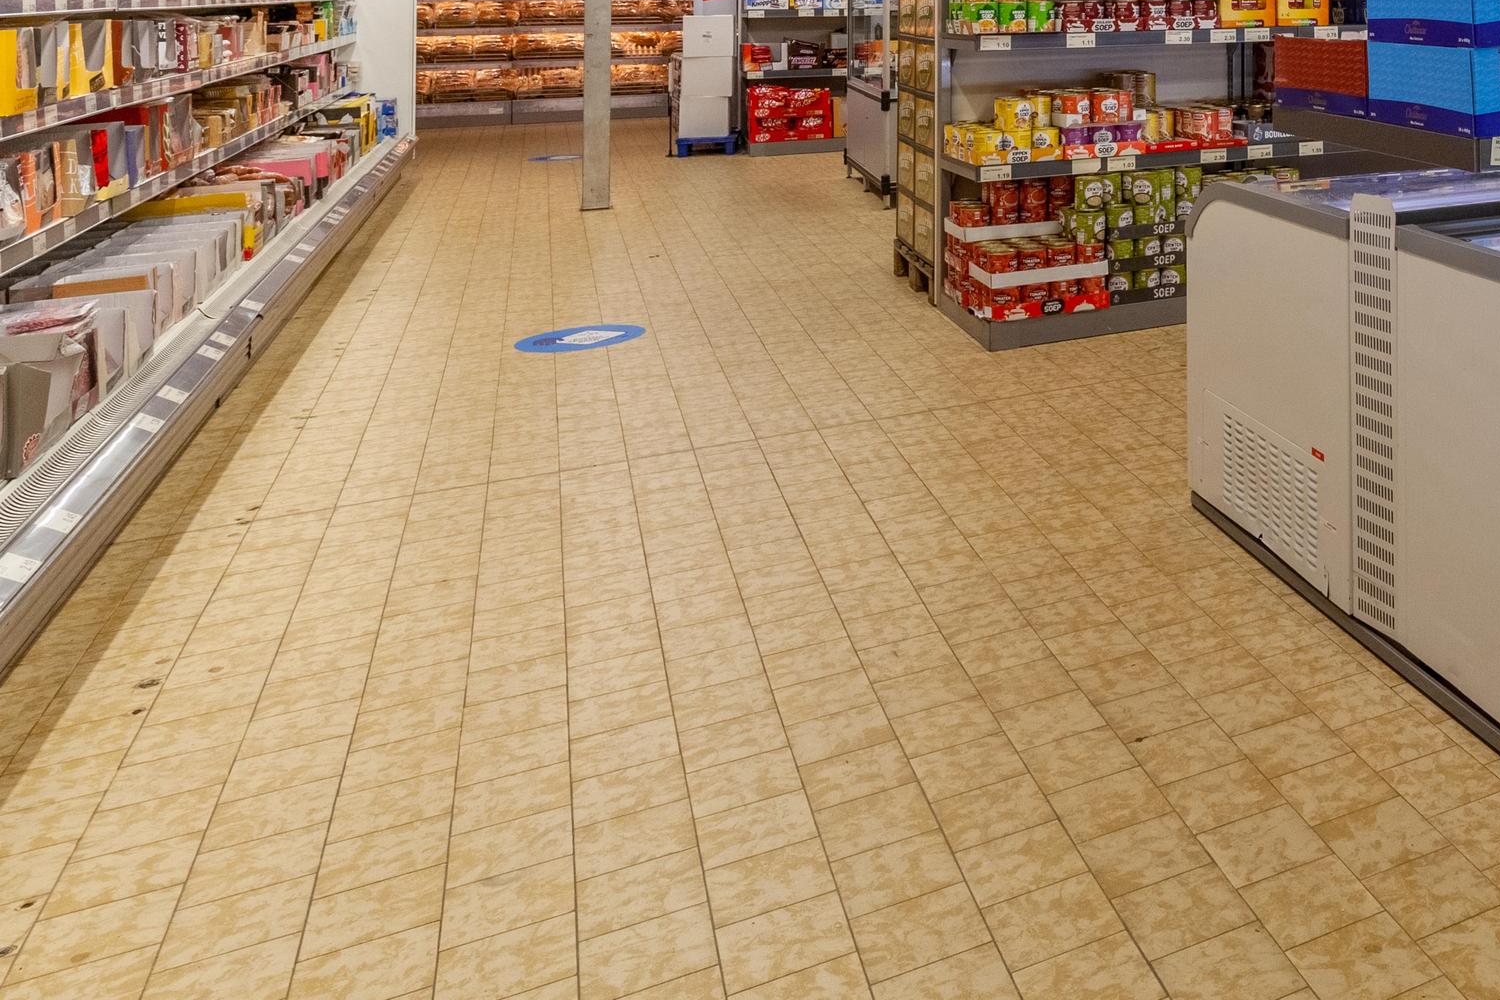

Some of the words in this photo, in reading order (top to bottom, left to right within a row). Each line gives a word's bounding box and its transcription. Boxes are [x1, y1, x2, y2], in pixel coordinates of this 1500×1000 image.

[751, 0, 779, 8] Knoppers
[1011, 155, 1029, 163] SOEP
[1153, 223, 1175, 235] SOEP
[1153, 254, 1176, 266] SOEP
[1153, 287, 1176, 298] SOEP
[1043, 303, 1062, 313] SOEP
